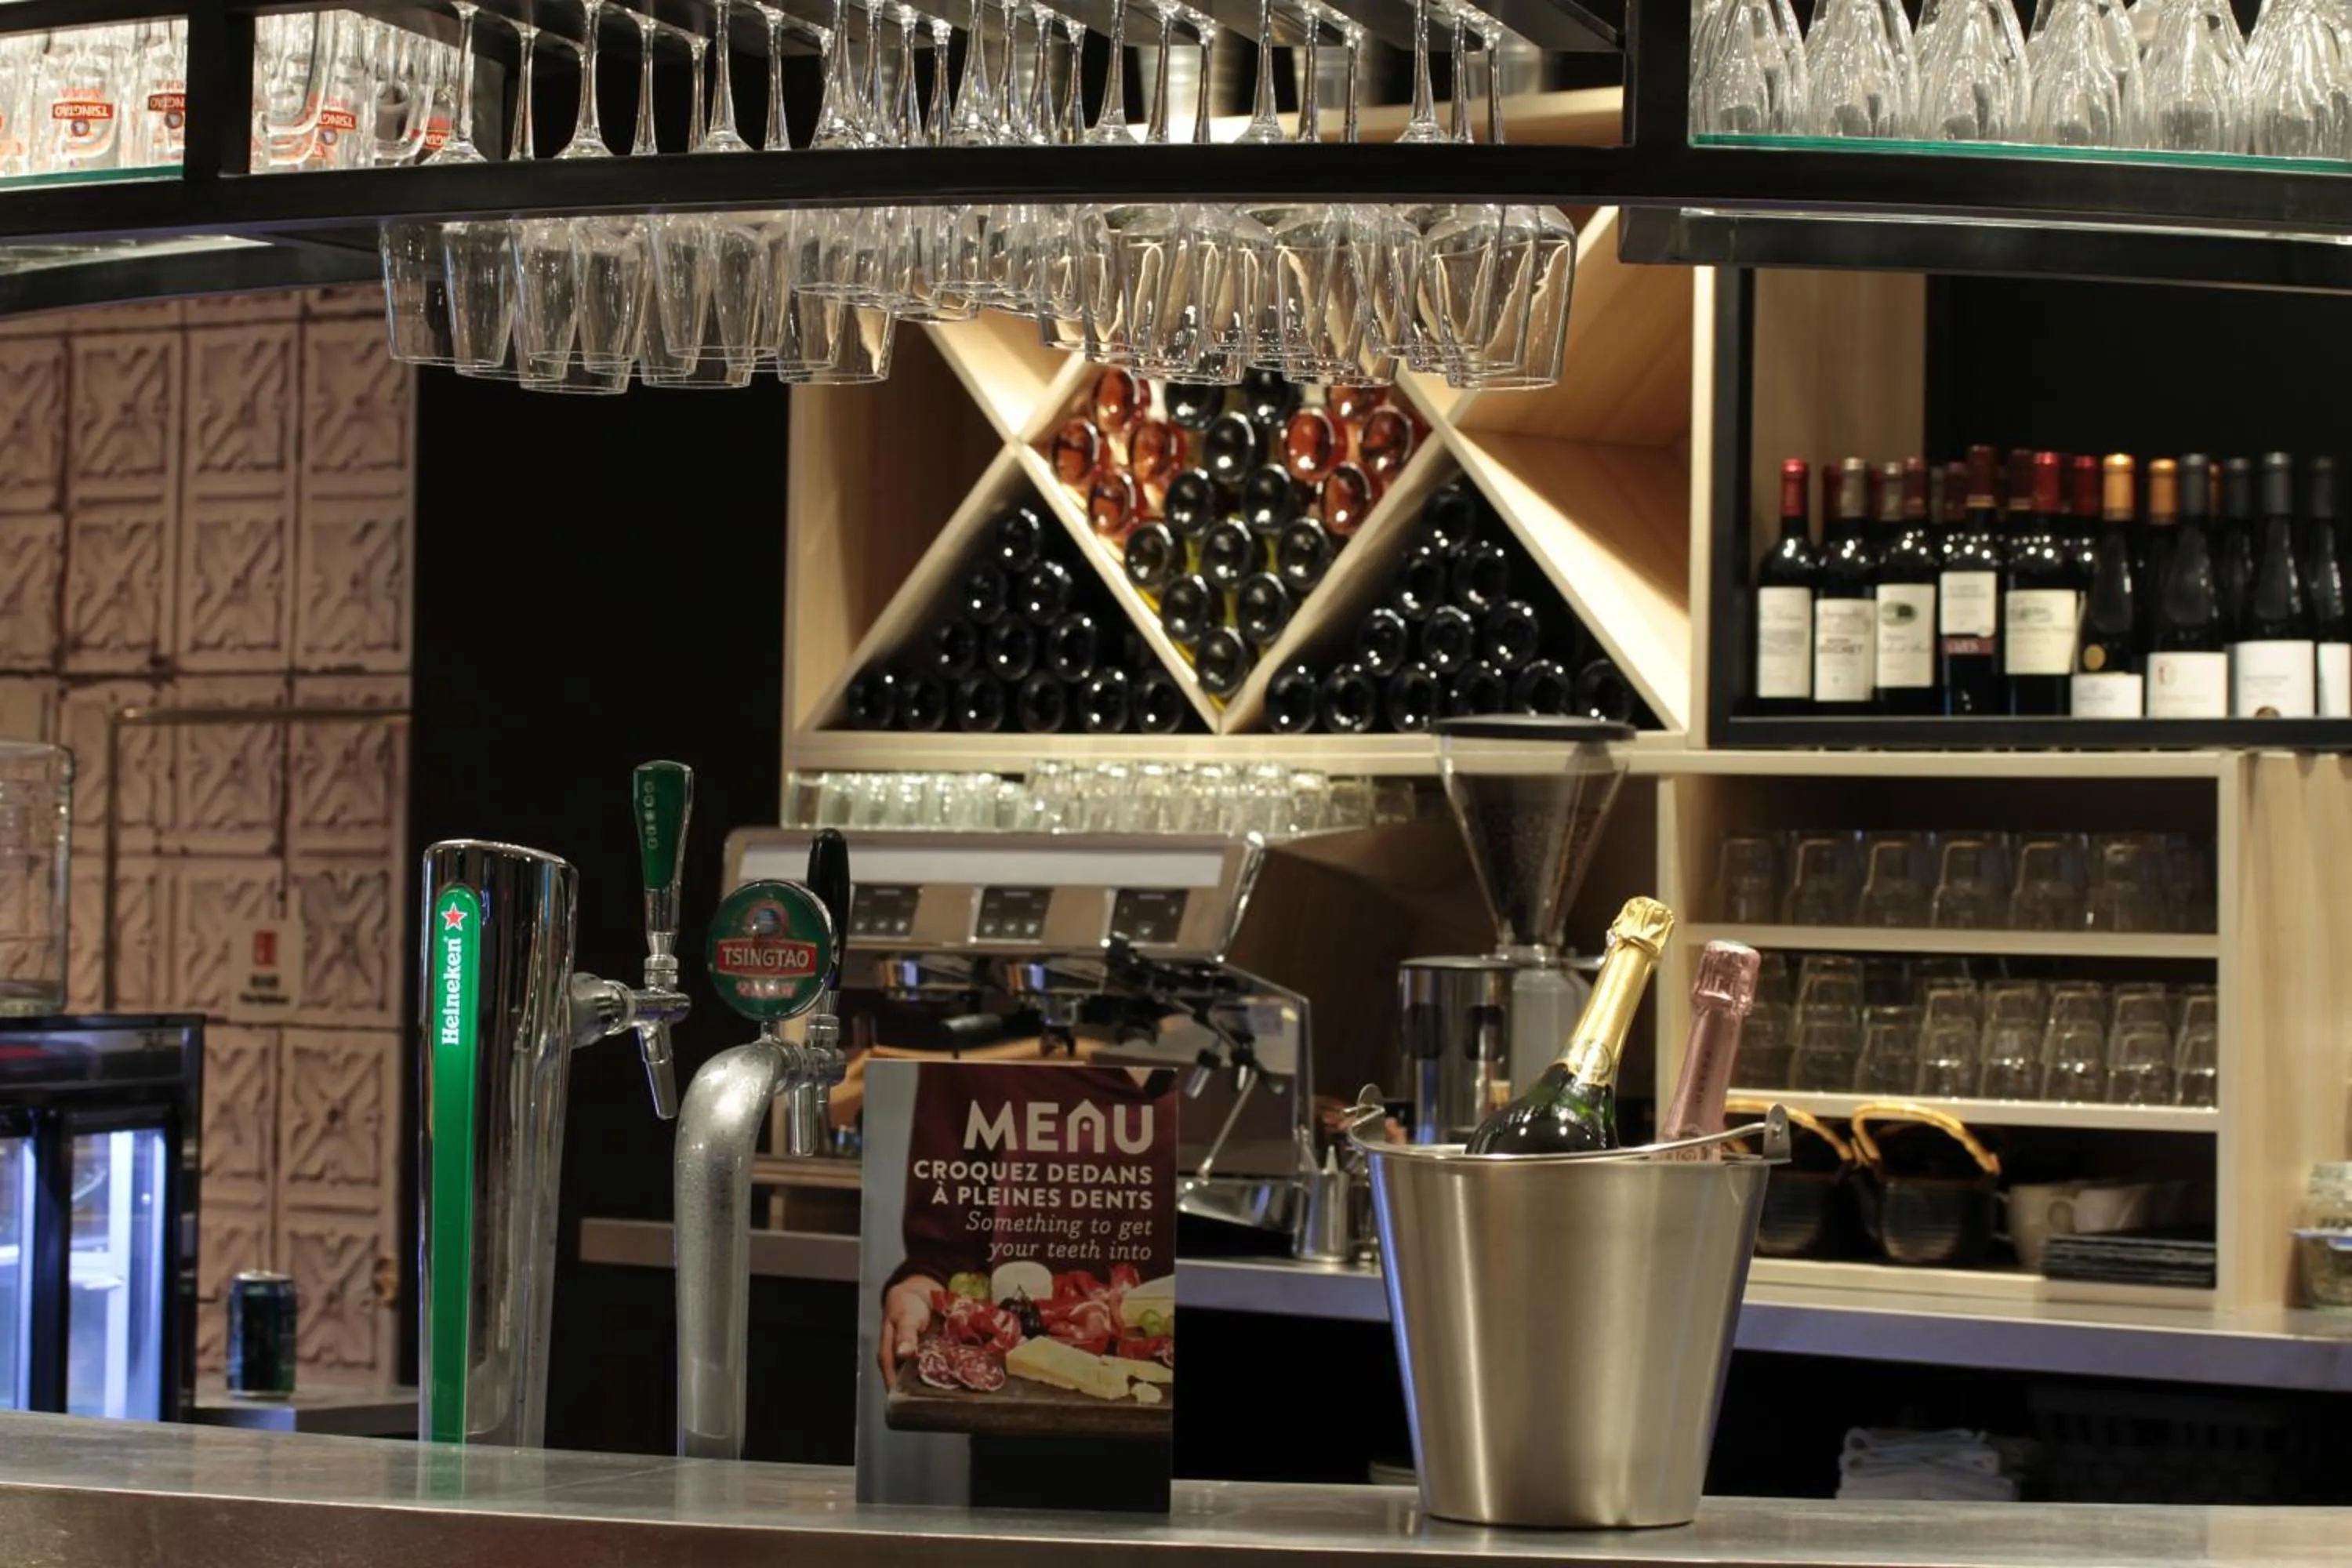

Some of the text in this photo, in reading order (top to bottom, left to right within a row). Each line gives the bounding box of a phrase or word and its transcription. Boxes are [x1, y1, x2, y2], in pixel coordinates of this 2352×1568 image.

[55, 104, 108, 116] TSINGTAO
[722, 946, 810, 969] TSINGTAO
[441, 938, 462, 1046] Heineken
[913, 1160, 1153, 1186] CROQUEZ DEDANS
[931, 1180, 1153, 1210] À PLEINES DENTS
[965, 1210, 1153, 1242] Something to get
[985, 1237, 1152, 1262] your teeth into
